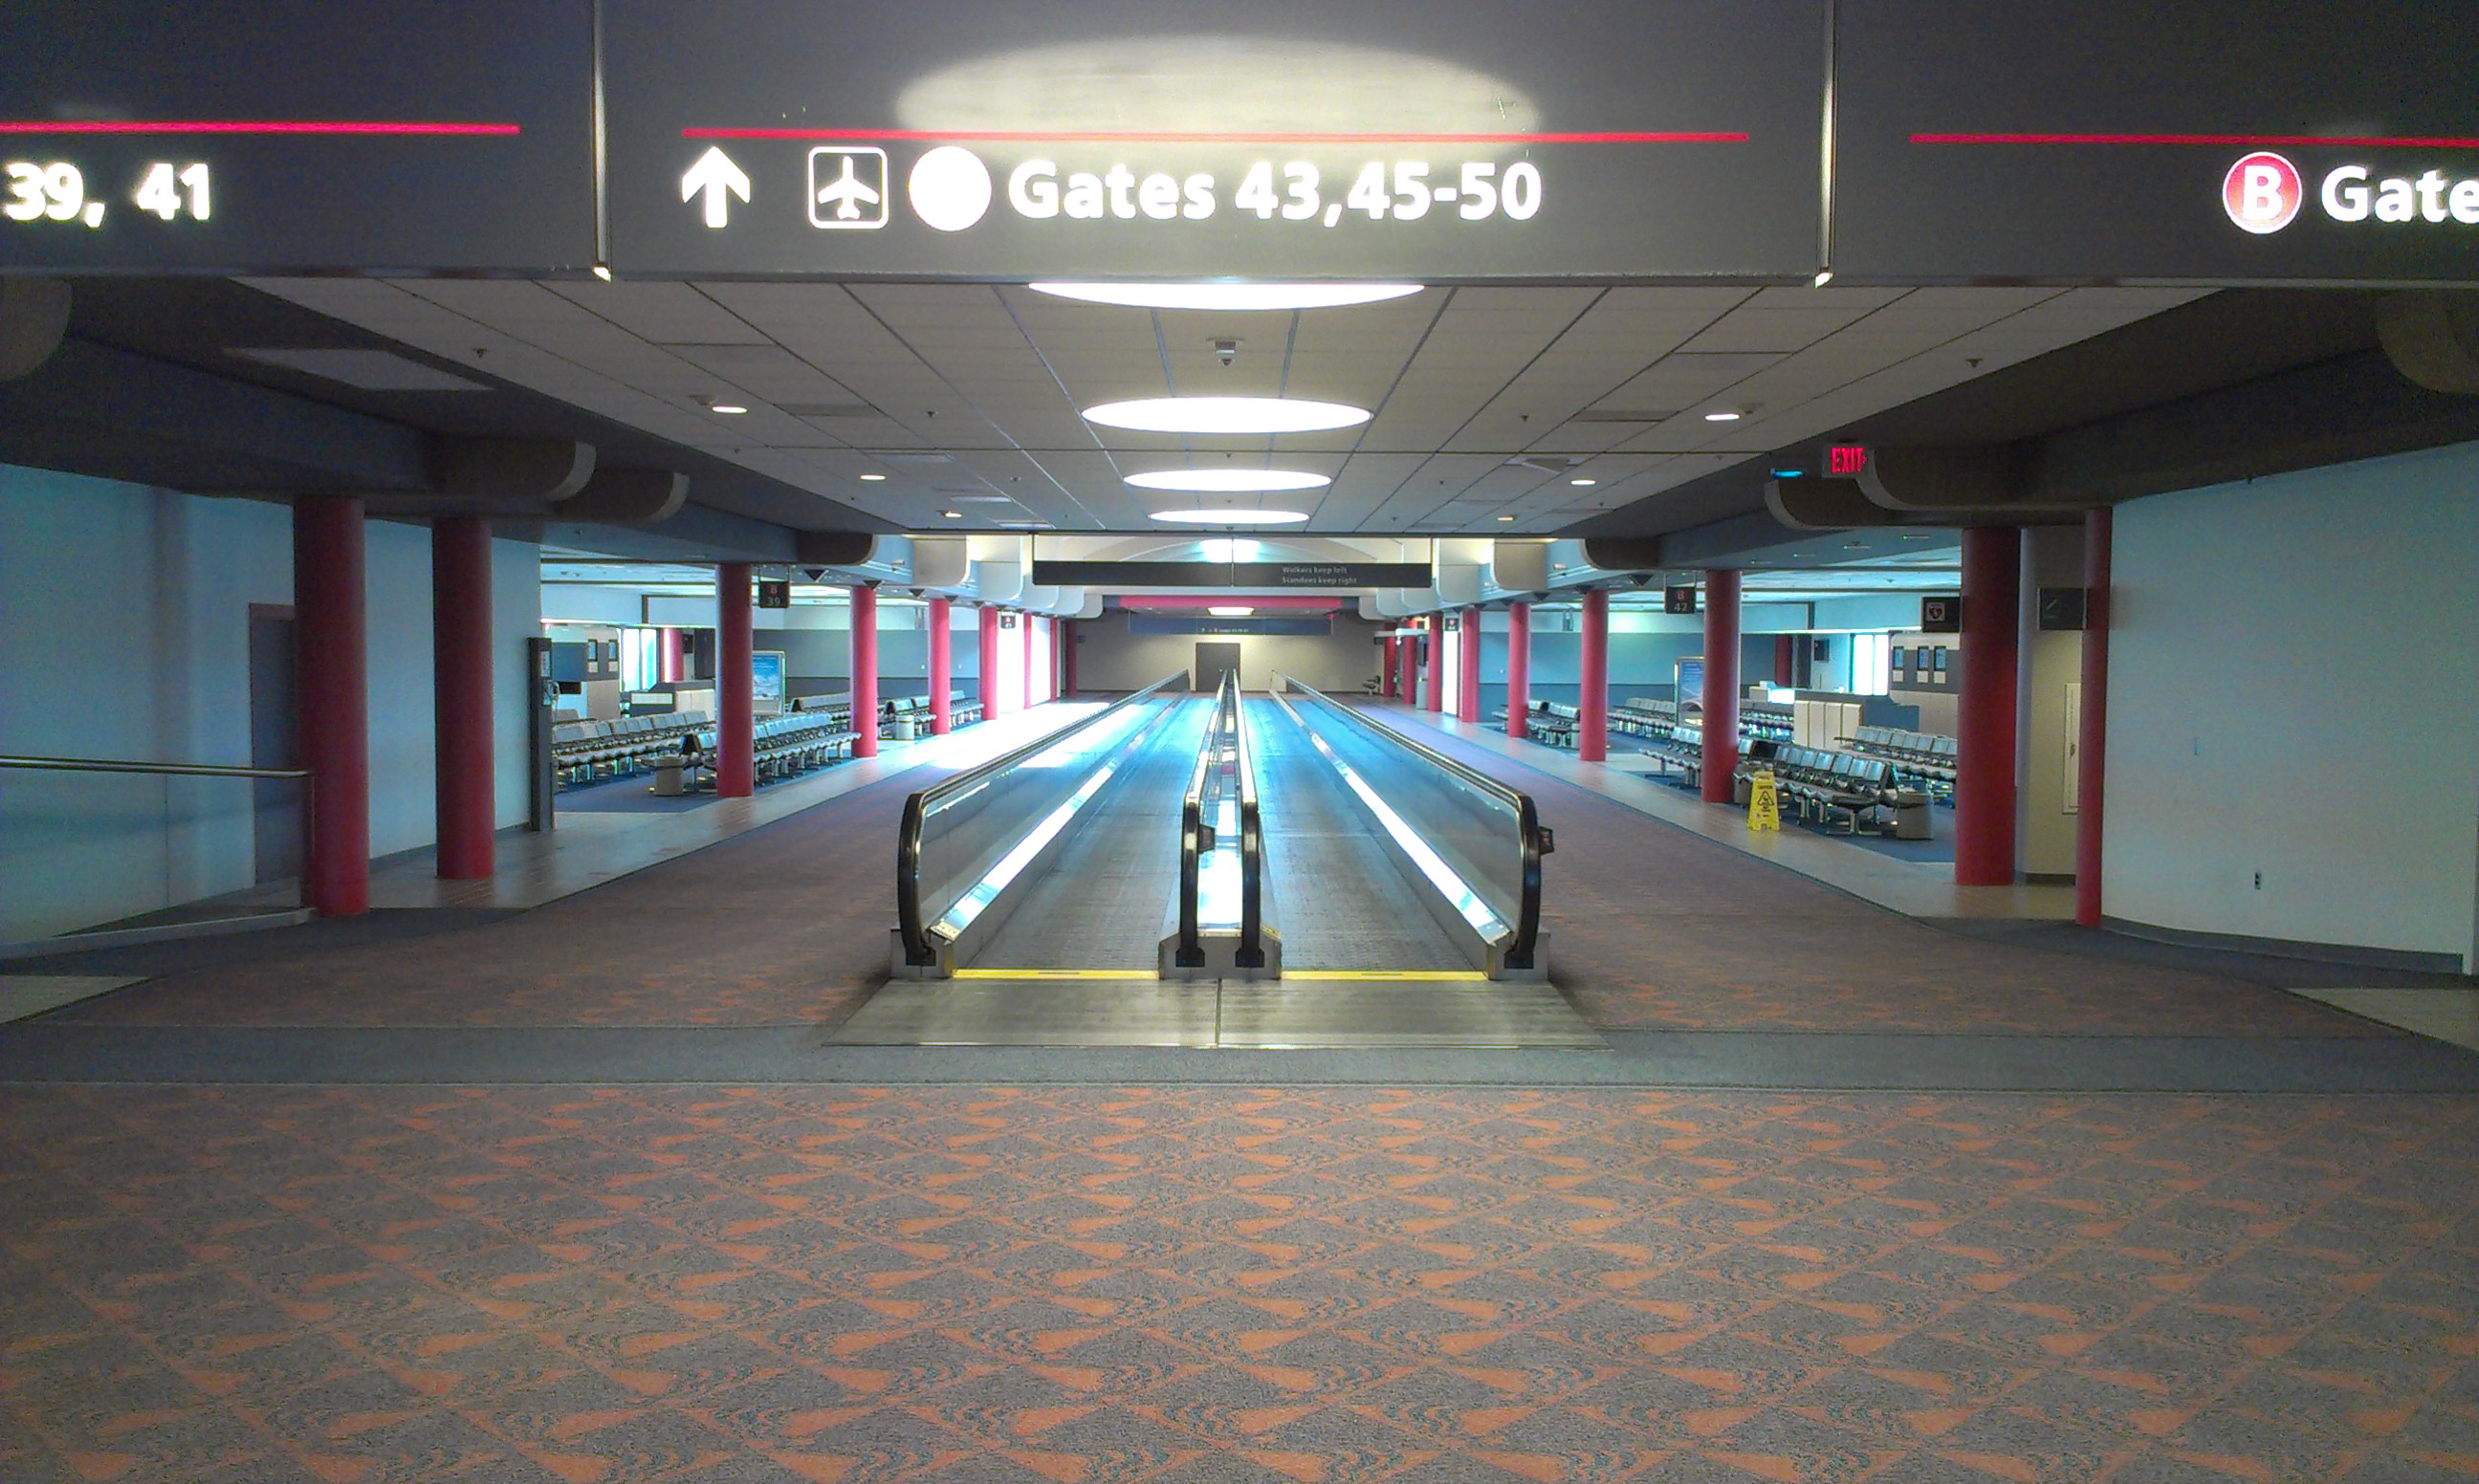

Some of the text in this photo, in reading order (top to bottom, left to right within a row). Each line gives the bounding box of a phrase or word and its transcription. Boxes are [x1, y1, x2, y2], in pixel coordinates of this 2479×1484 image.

[3, 162, 211, 228] 39, 41
[1008, 157, 1543, 229] Gates 43,45-50
[2242, 164, 2285, 221] B
[1831, 447, 1864, 473] EXIT
[1313, 566, 1332, 576] keep
[1282, 576, 1357, 585] Standees keep right
[770, 585, 779, 595] B
[767, 597, 781, 606] 39
[1674, 602, 1688, 612] 42
